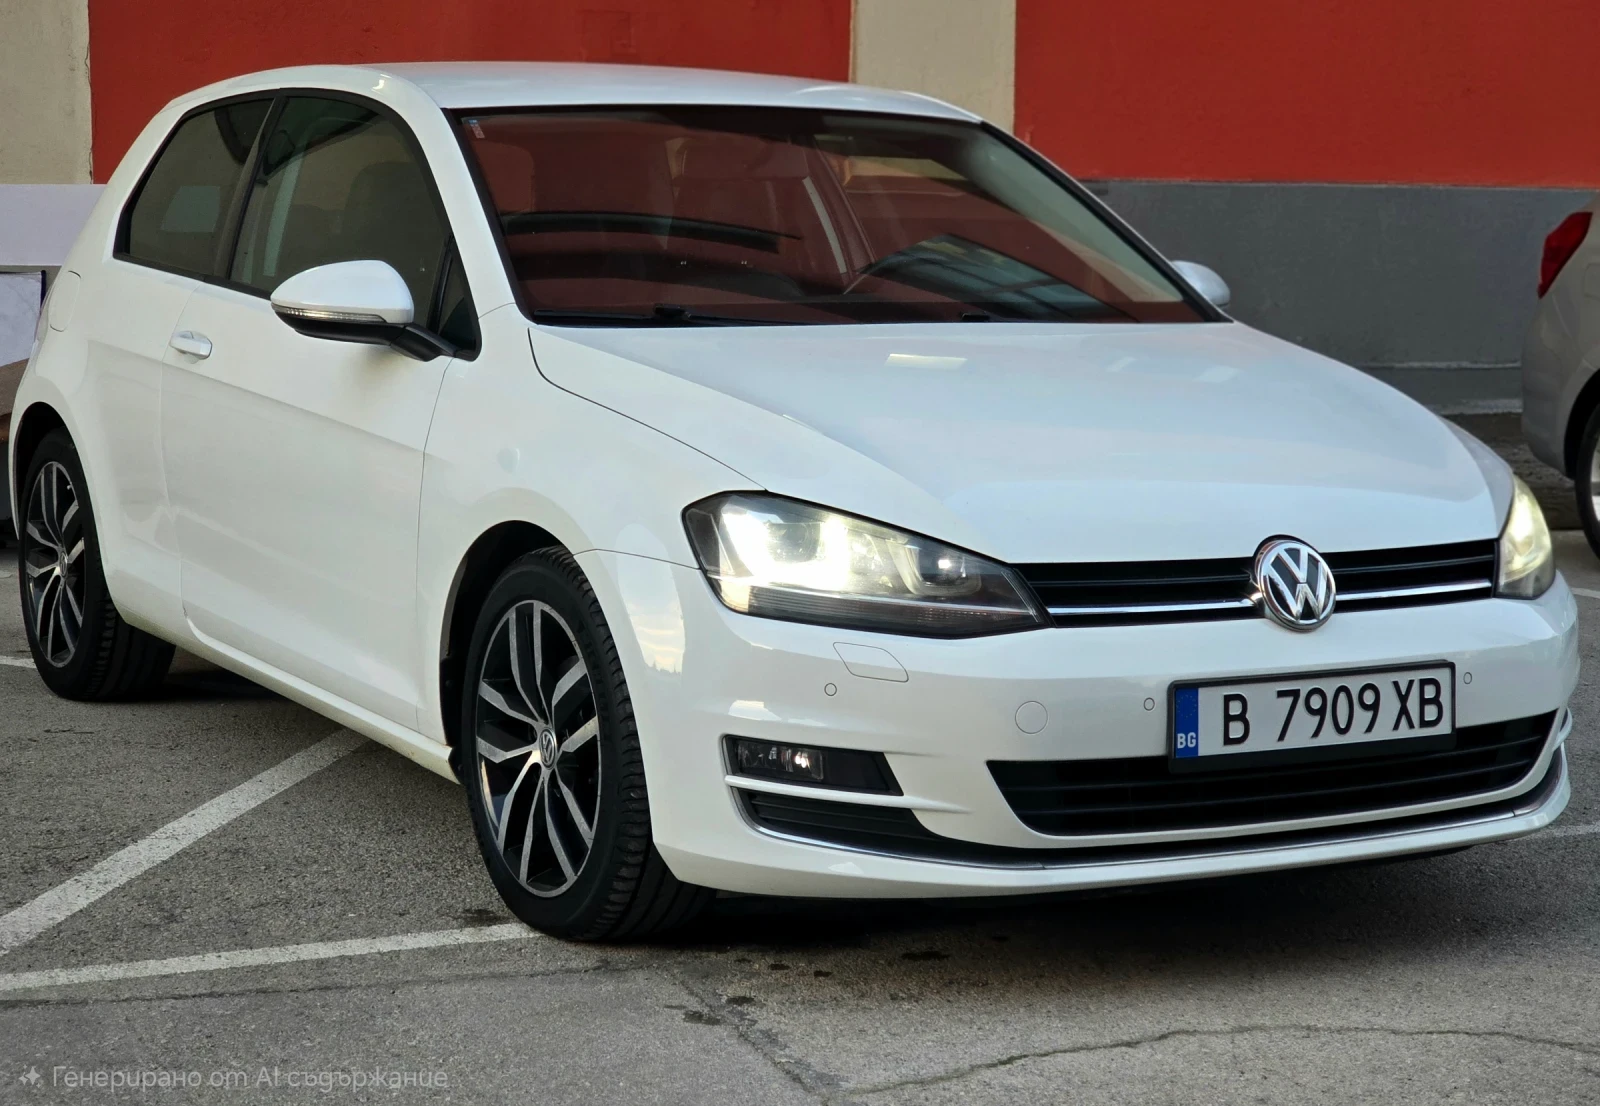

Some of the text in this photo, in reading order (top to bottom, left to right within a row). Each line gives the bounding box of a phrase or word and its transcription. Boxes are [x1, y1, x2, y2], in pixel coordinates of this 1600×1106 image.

[1223, 677, 1444, 746] B 7909 XB
[1176, 732, 1197, 749] BG
